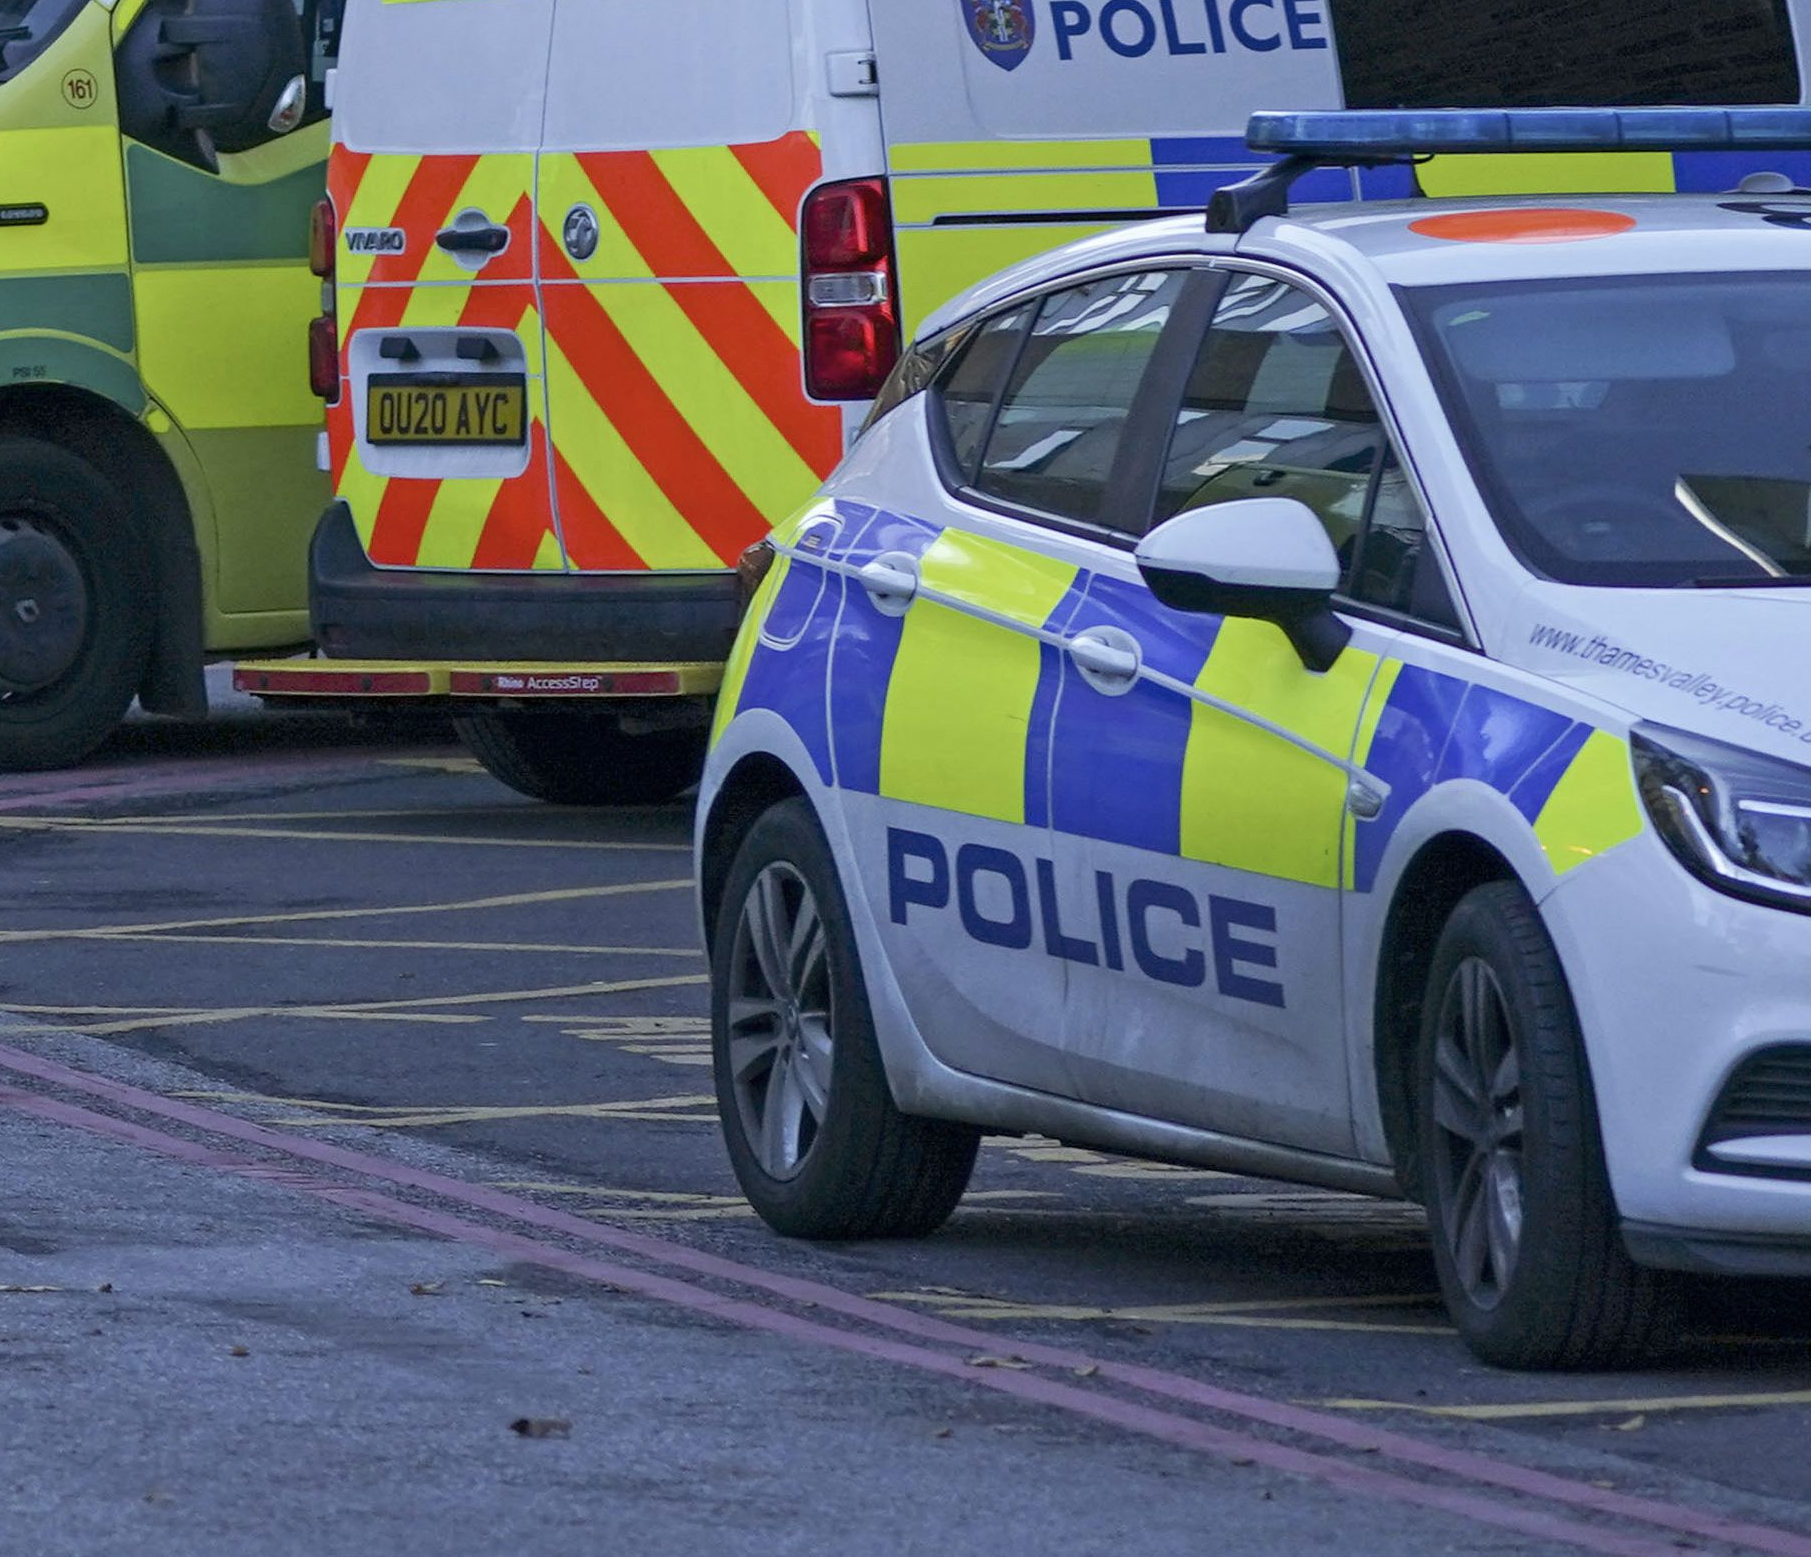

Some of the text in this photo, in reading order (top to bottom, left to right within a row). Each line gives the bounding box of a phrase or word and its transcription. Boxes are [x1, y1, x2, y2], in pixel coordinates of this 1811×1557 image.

[66, 78, 94, 101] 161
[344, 230, 404, 252] VIVARO
[379, 391, 510, 436] OU20 AYC
[886, 825, 1287, 1009] POLICE
